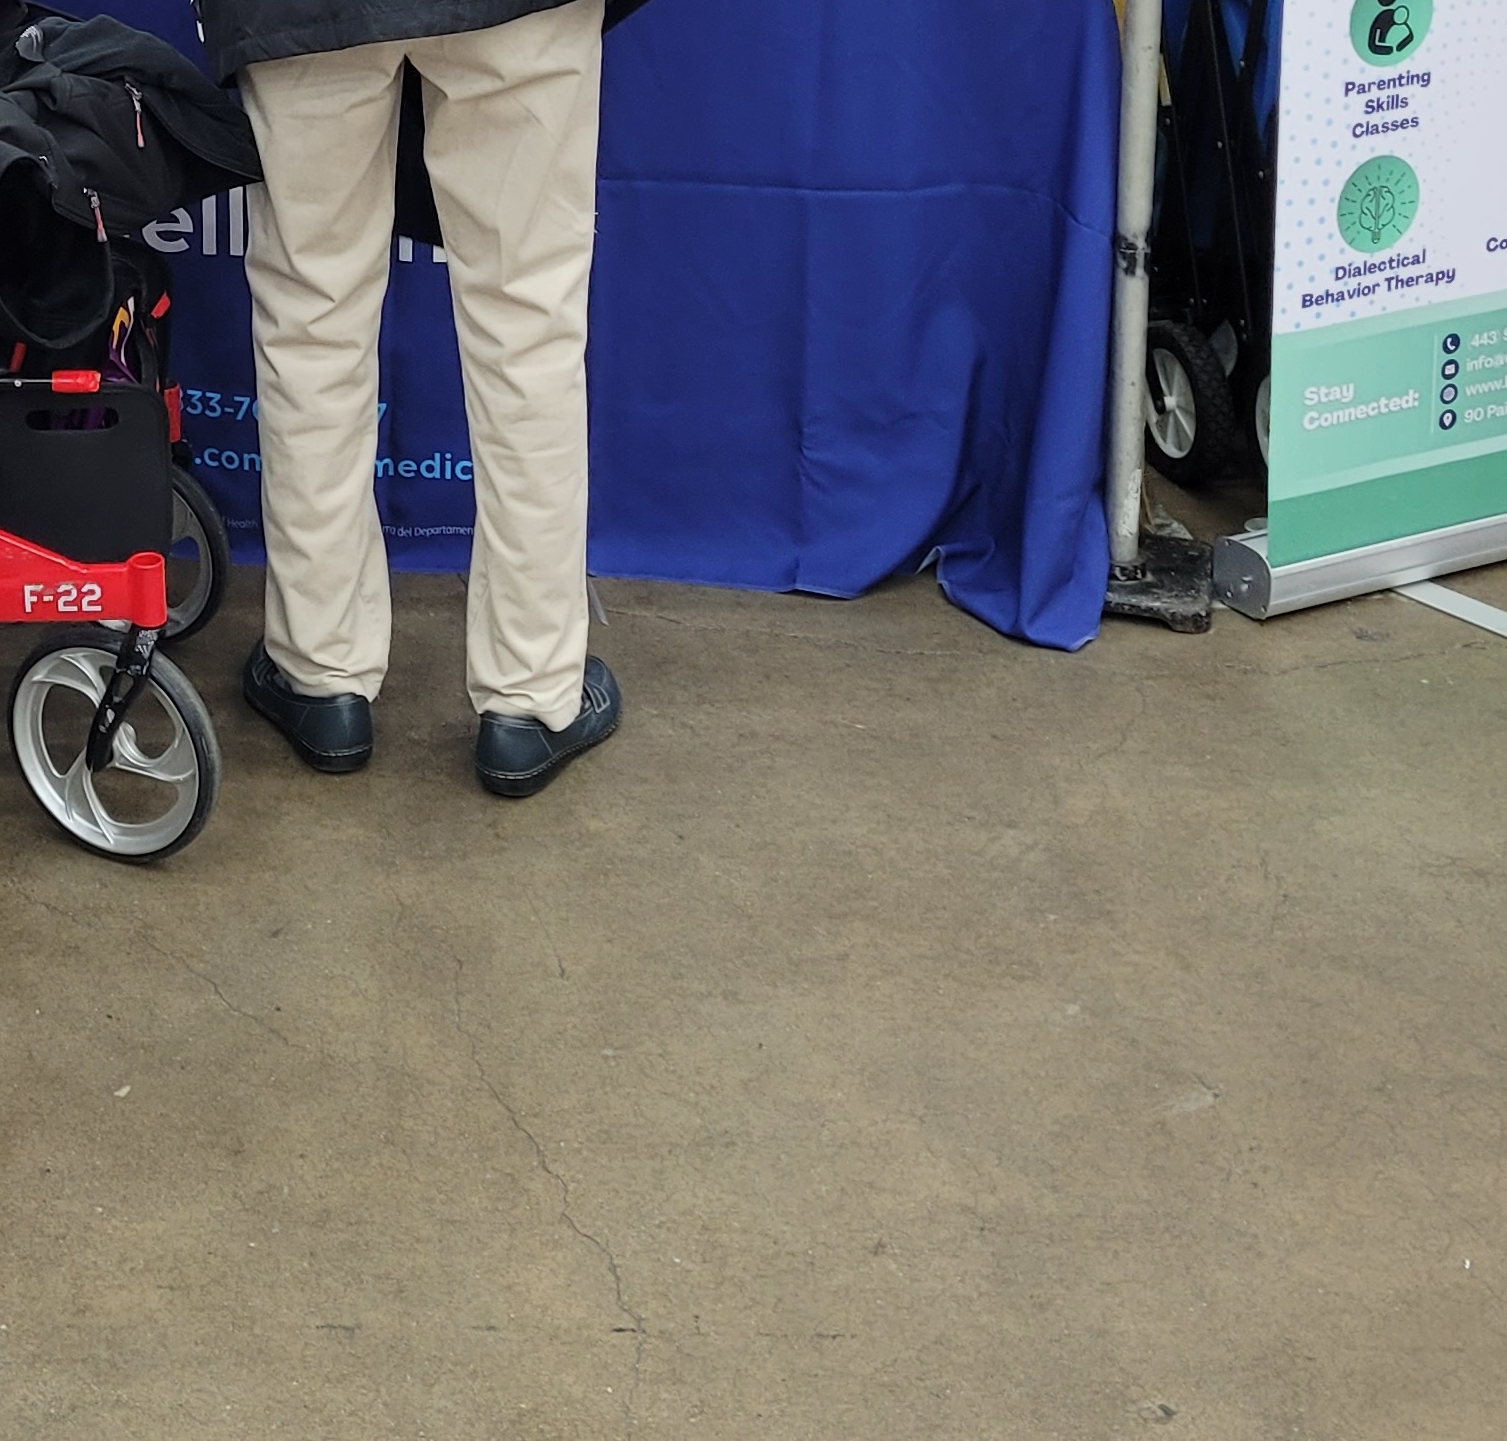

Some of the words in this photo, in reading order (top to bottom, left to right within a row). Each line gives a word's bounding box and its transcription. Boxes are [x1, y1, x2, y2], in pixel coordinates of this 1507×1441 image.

[1343, 69, 1432, 97] Parenting
[1363, 93, 1409, 115] Skills
[1351, 115, 1420, 138] Classes
[1334, 248, 1427, 282] Dialectical
[1301, 283, 1380, 309] Behavior
[1384, 266, 1457, 293] Therapy
[1303, 382, 1355, 407] Stay
[1302, 388, 1421, 431] Connected:
[23, 582, 103, 613] F-22
